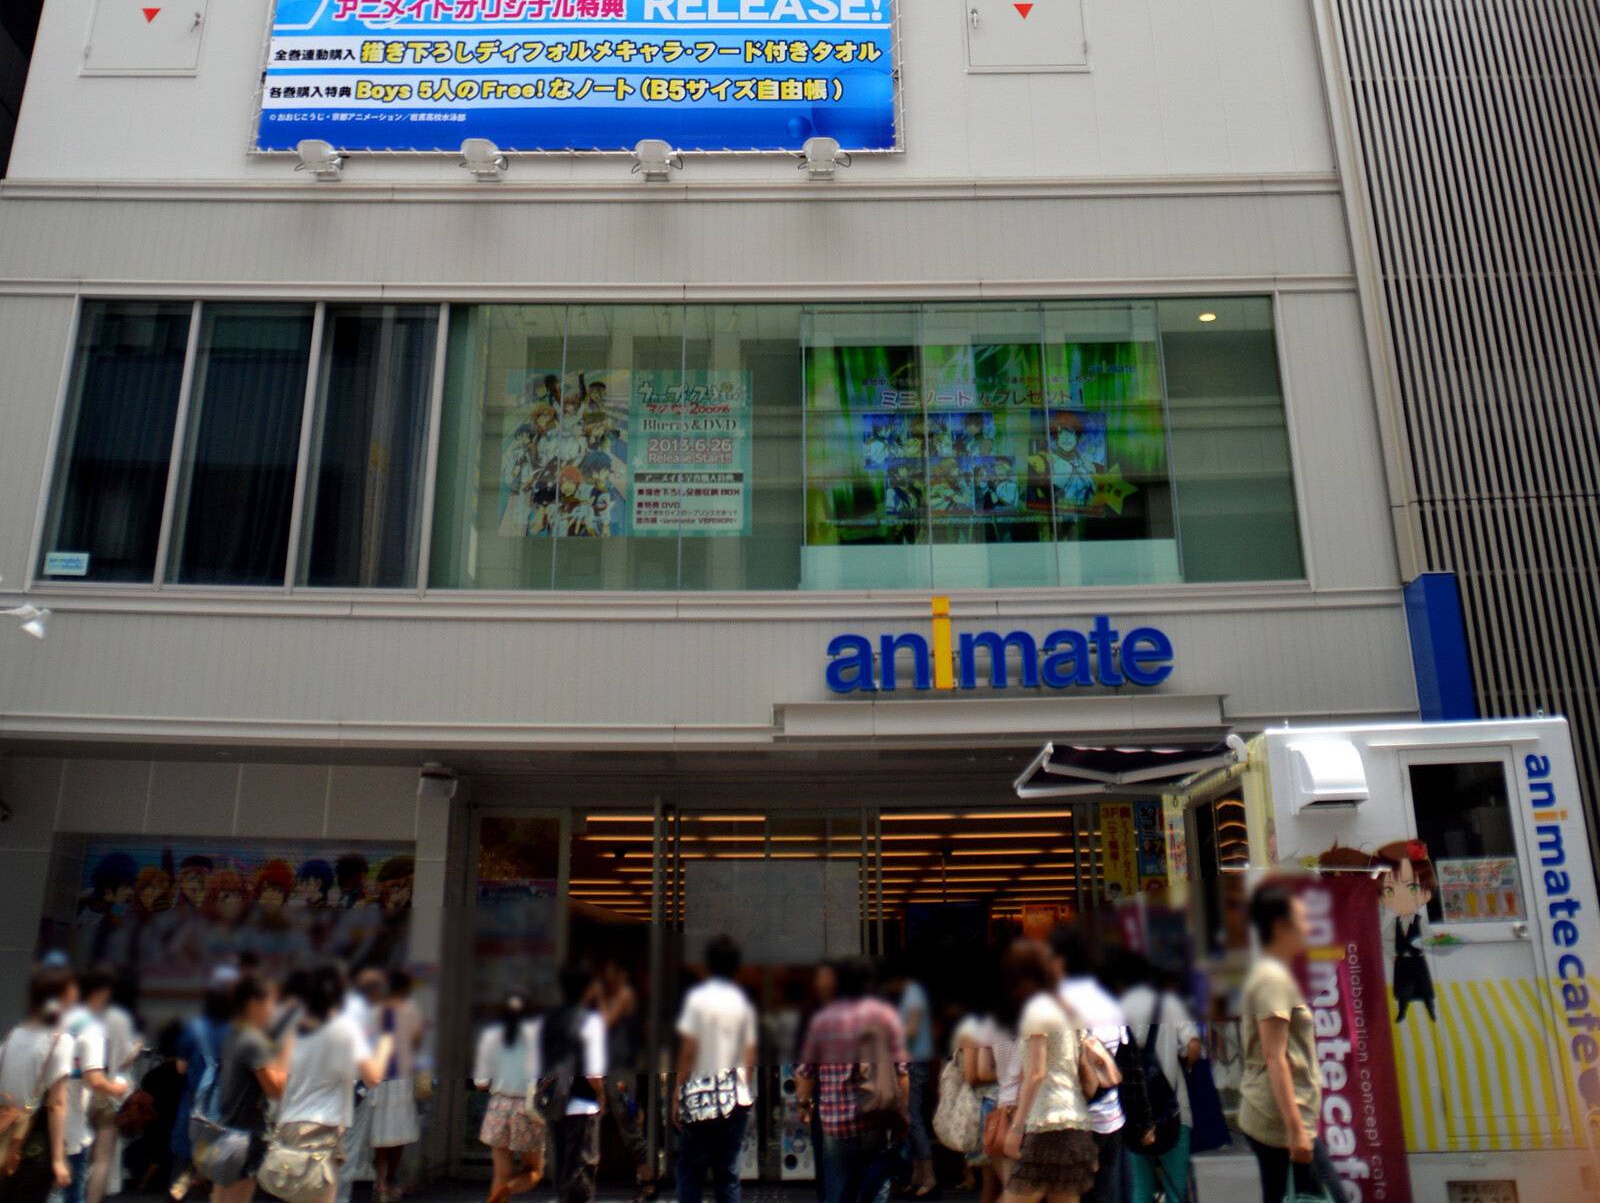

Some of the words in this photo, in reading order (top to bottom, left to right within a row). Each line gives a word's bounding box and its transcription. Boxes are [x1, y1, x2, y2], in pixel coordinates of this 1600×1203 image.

[274, 49, 356, 61] 全巻連動購入
[269, 86, 352, 98] 各巻購入特典
[647, 437, 733, 453] 2013.6.26
[825, 597, 1173, 692] animate
